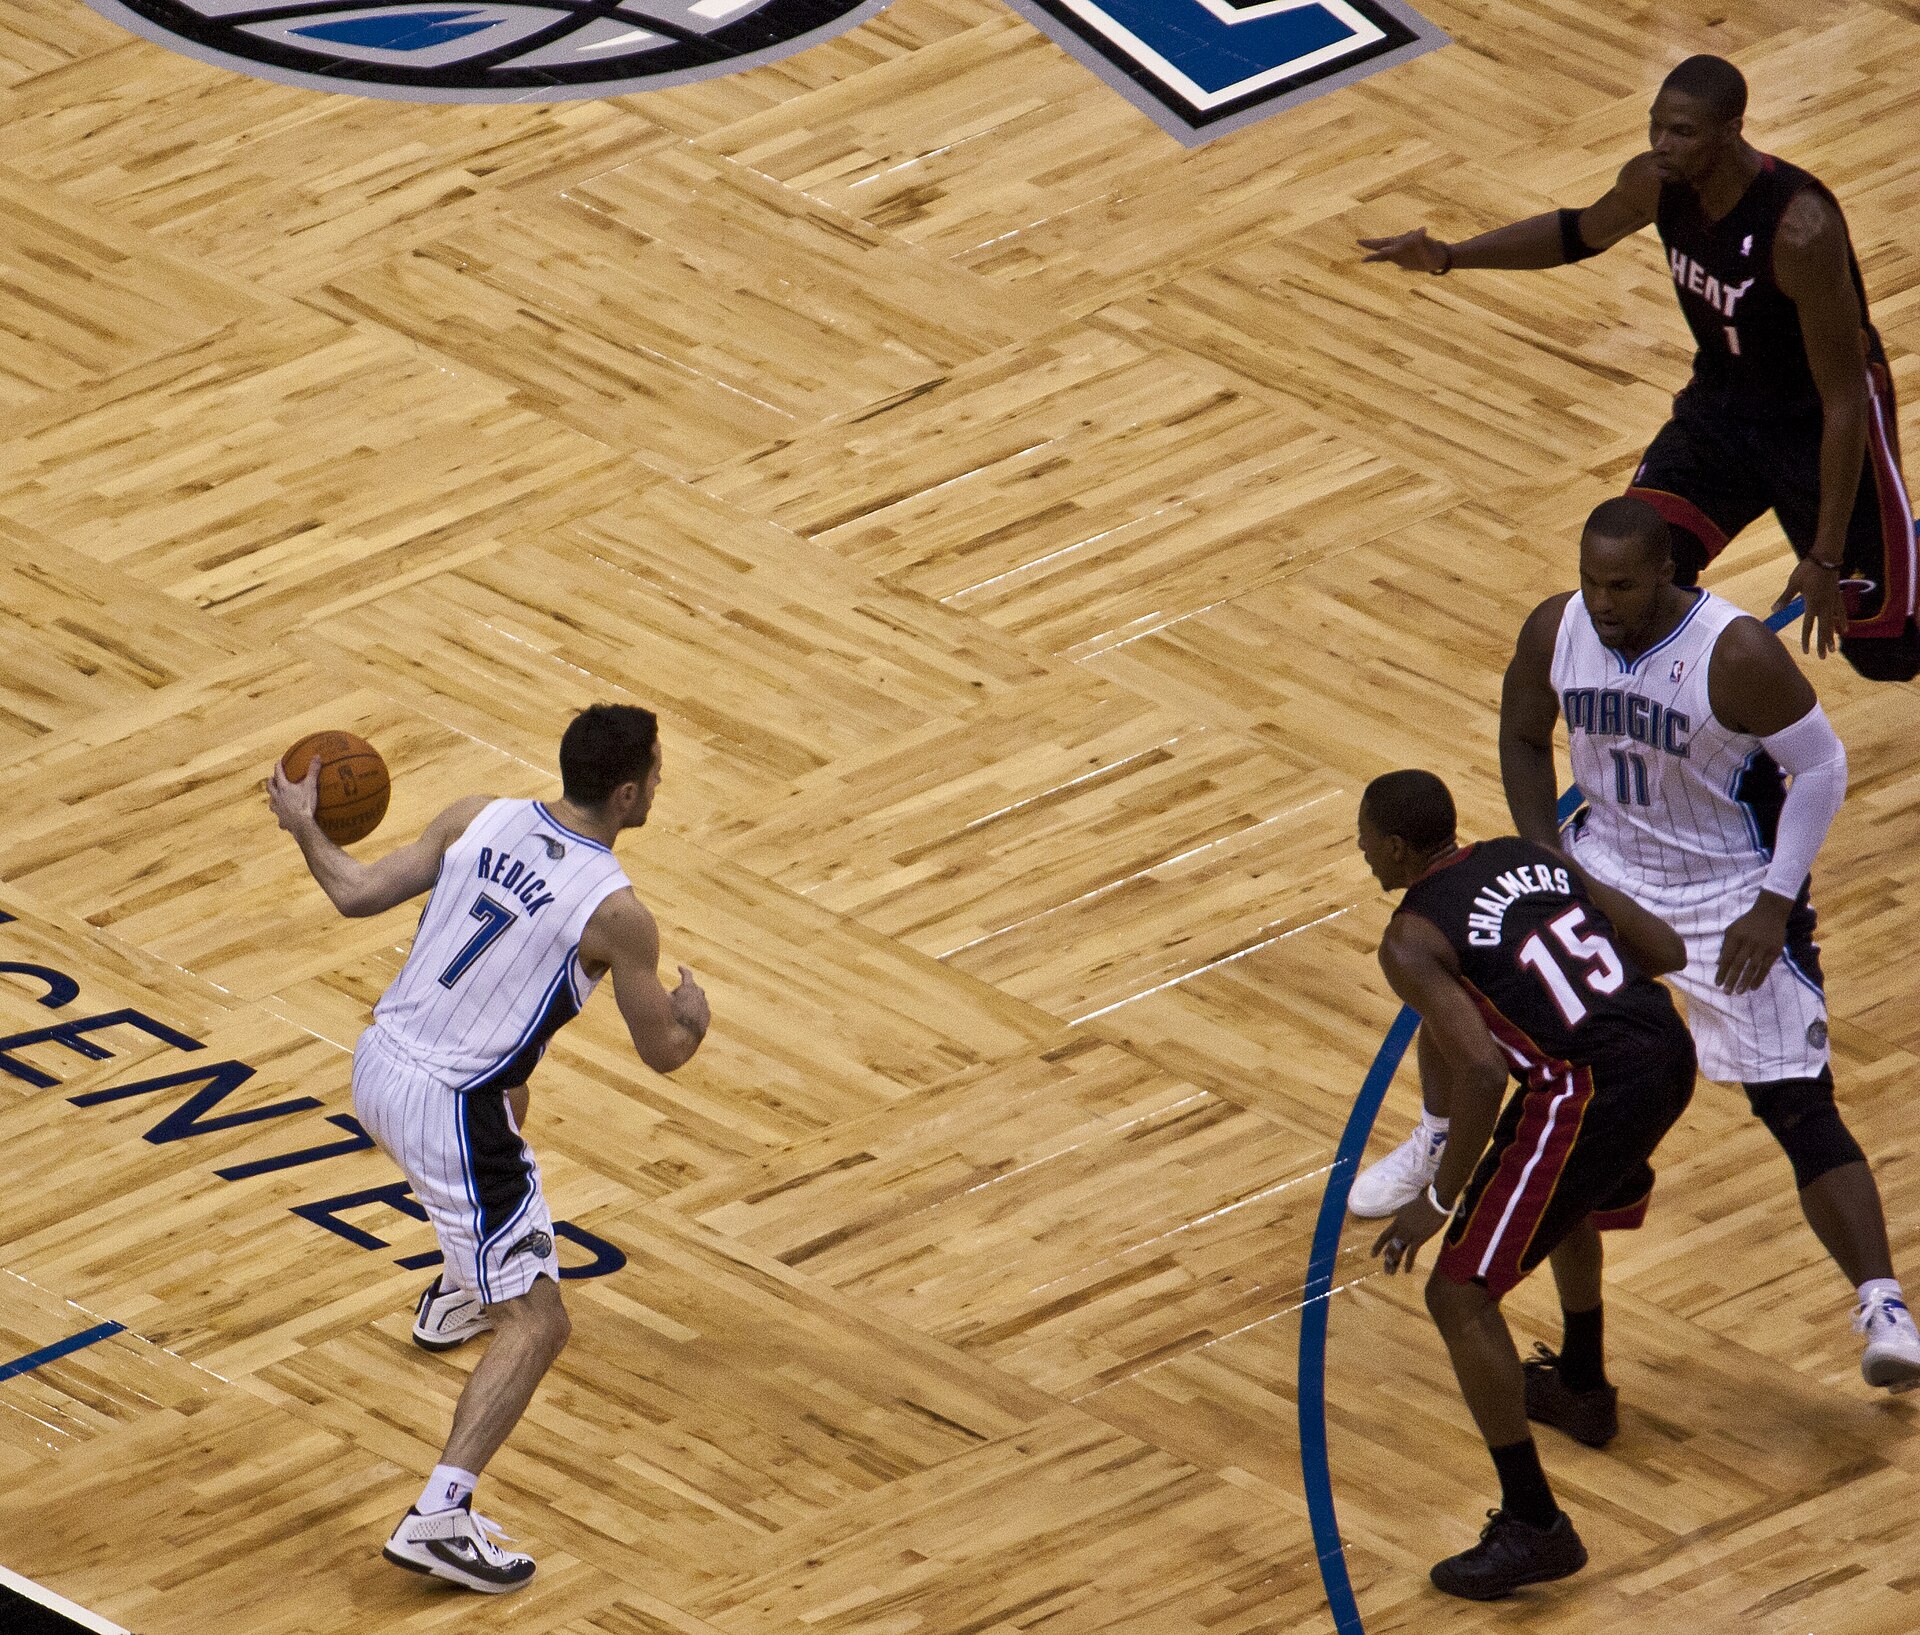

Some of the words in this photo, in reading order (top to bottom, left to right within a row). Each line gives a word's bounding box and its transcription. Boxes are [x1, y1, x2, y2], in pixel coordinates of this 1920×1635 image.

[1670, 247, 1755, 318] HEAT
[1723, 325, 1742, 356] 1
[1563, 687, 1690, 758] MAGIC
[1610, 749, 1650, 806] 11
[477, 846, 556, 918] REDICK
[1467, 863, 1571, 947] CHALMERS
[437, 891, 519, 990] 7
[1517, 904, 1624, 1028] 15
